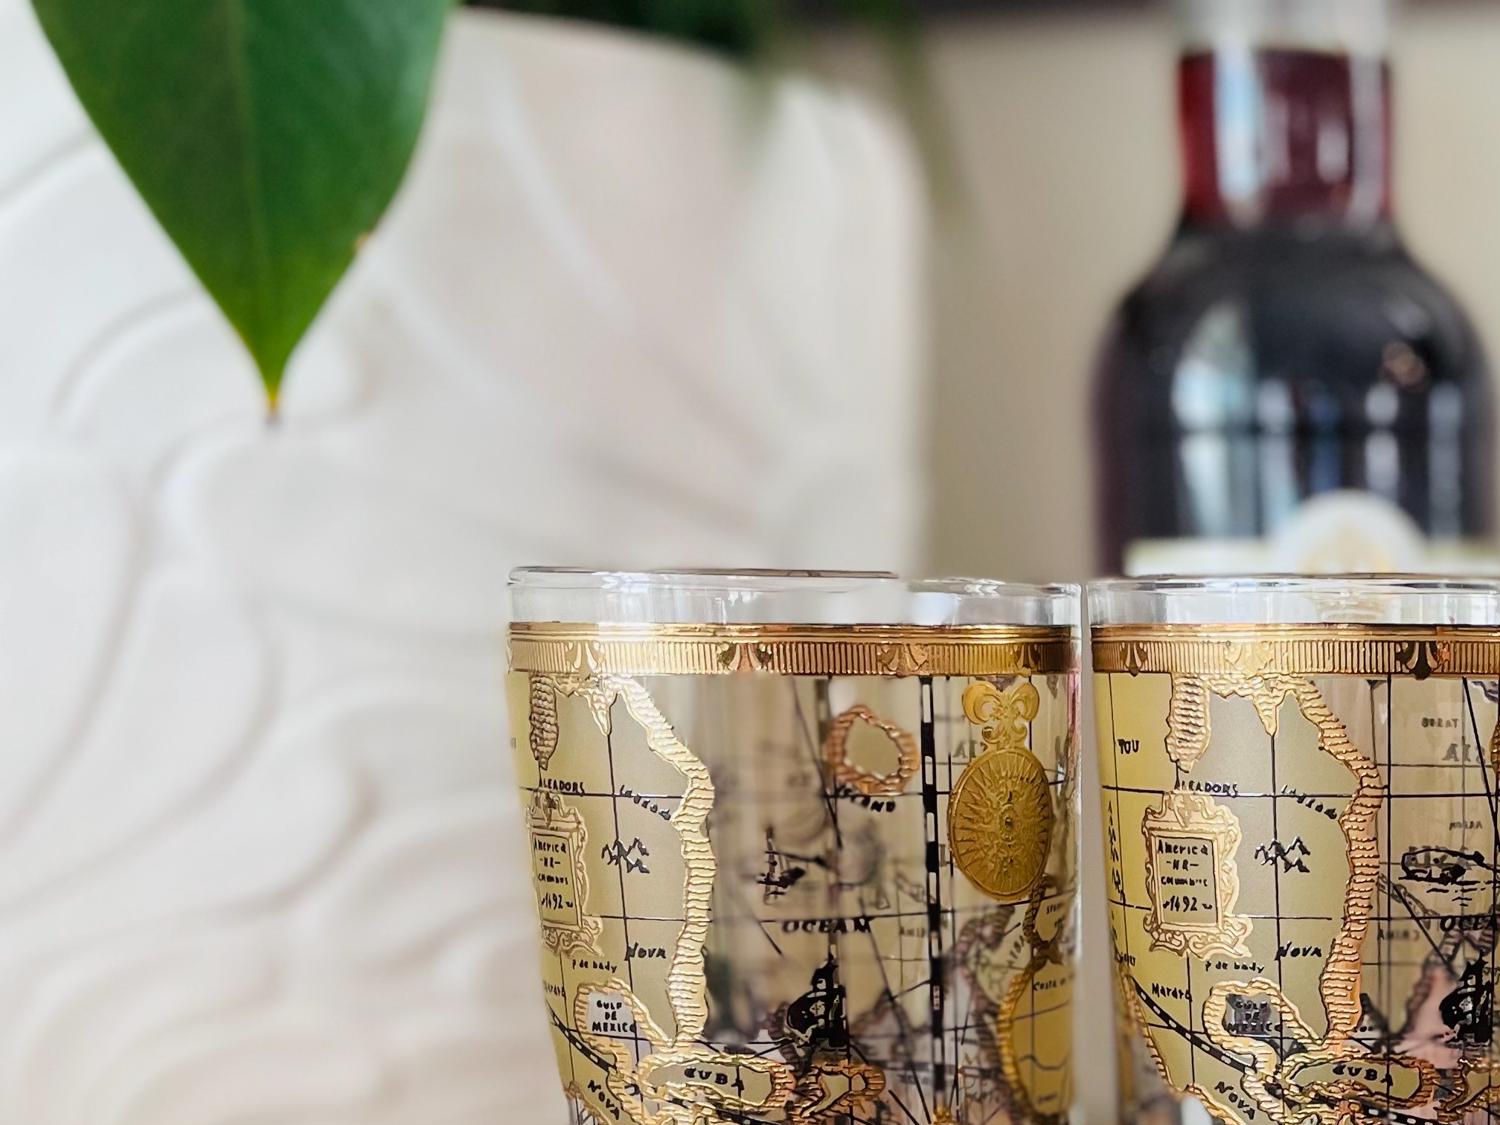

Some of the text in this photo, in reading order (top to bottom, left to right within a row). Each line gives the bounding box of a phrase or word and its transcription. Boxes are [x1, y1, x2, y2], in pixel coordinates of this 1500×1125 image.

[781, 917, 872, 933] OCEAN
[592, 1022, 637, 1033] MEXICO
[1227, 1022, 1283, 1033] MEXICO
[684, 1067, 744, 1093] CUBA
[1332, 1065, 1394, 1086] CUBA
